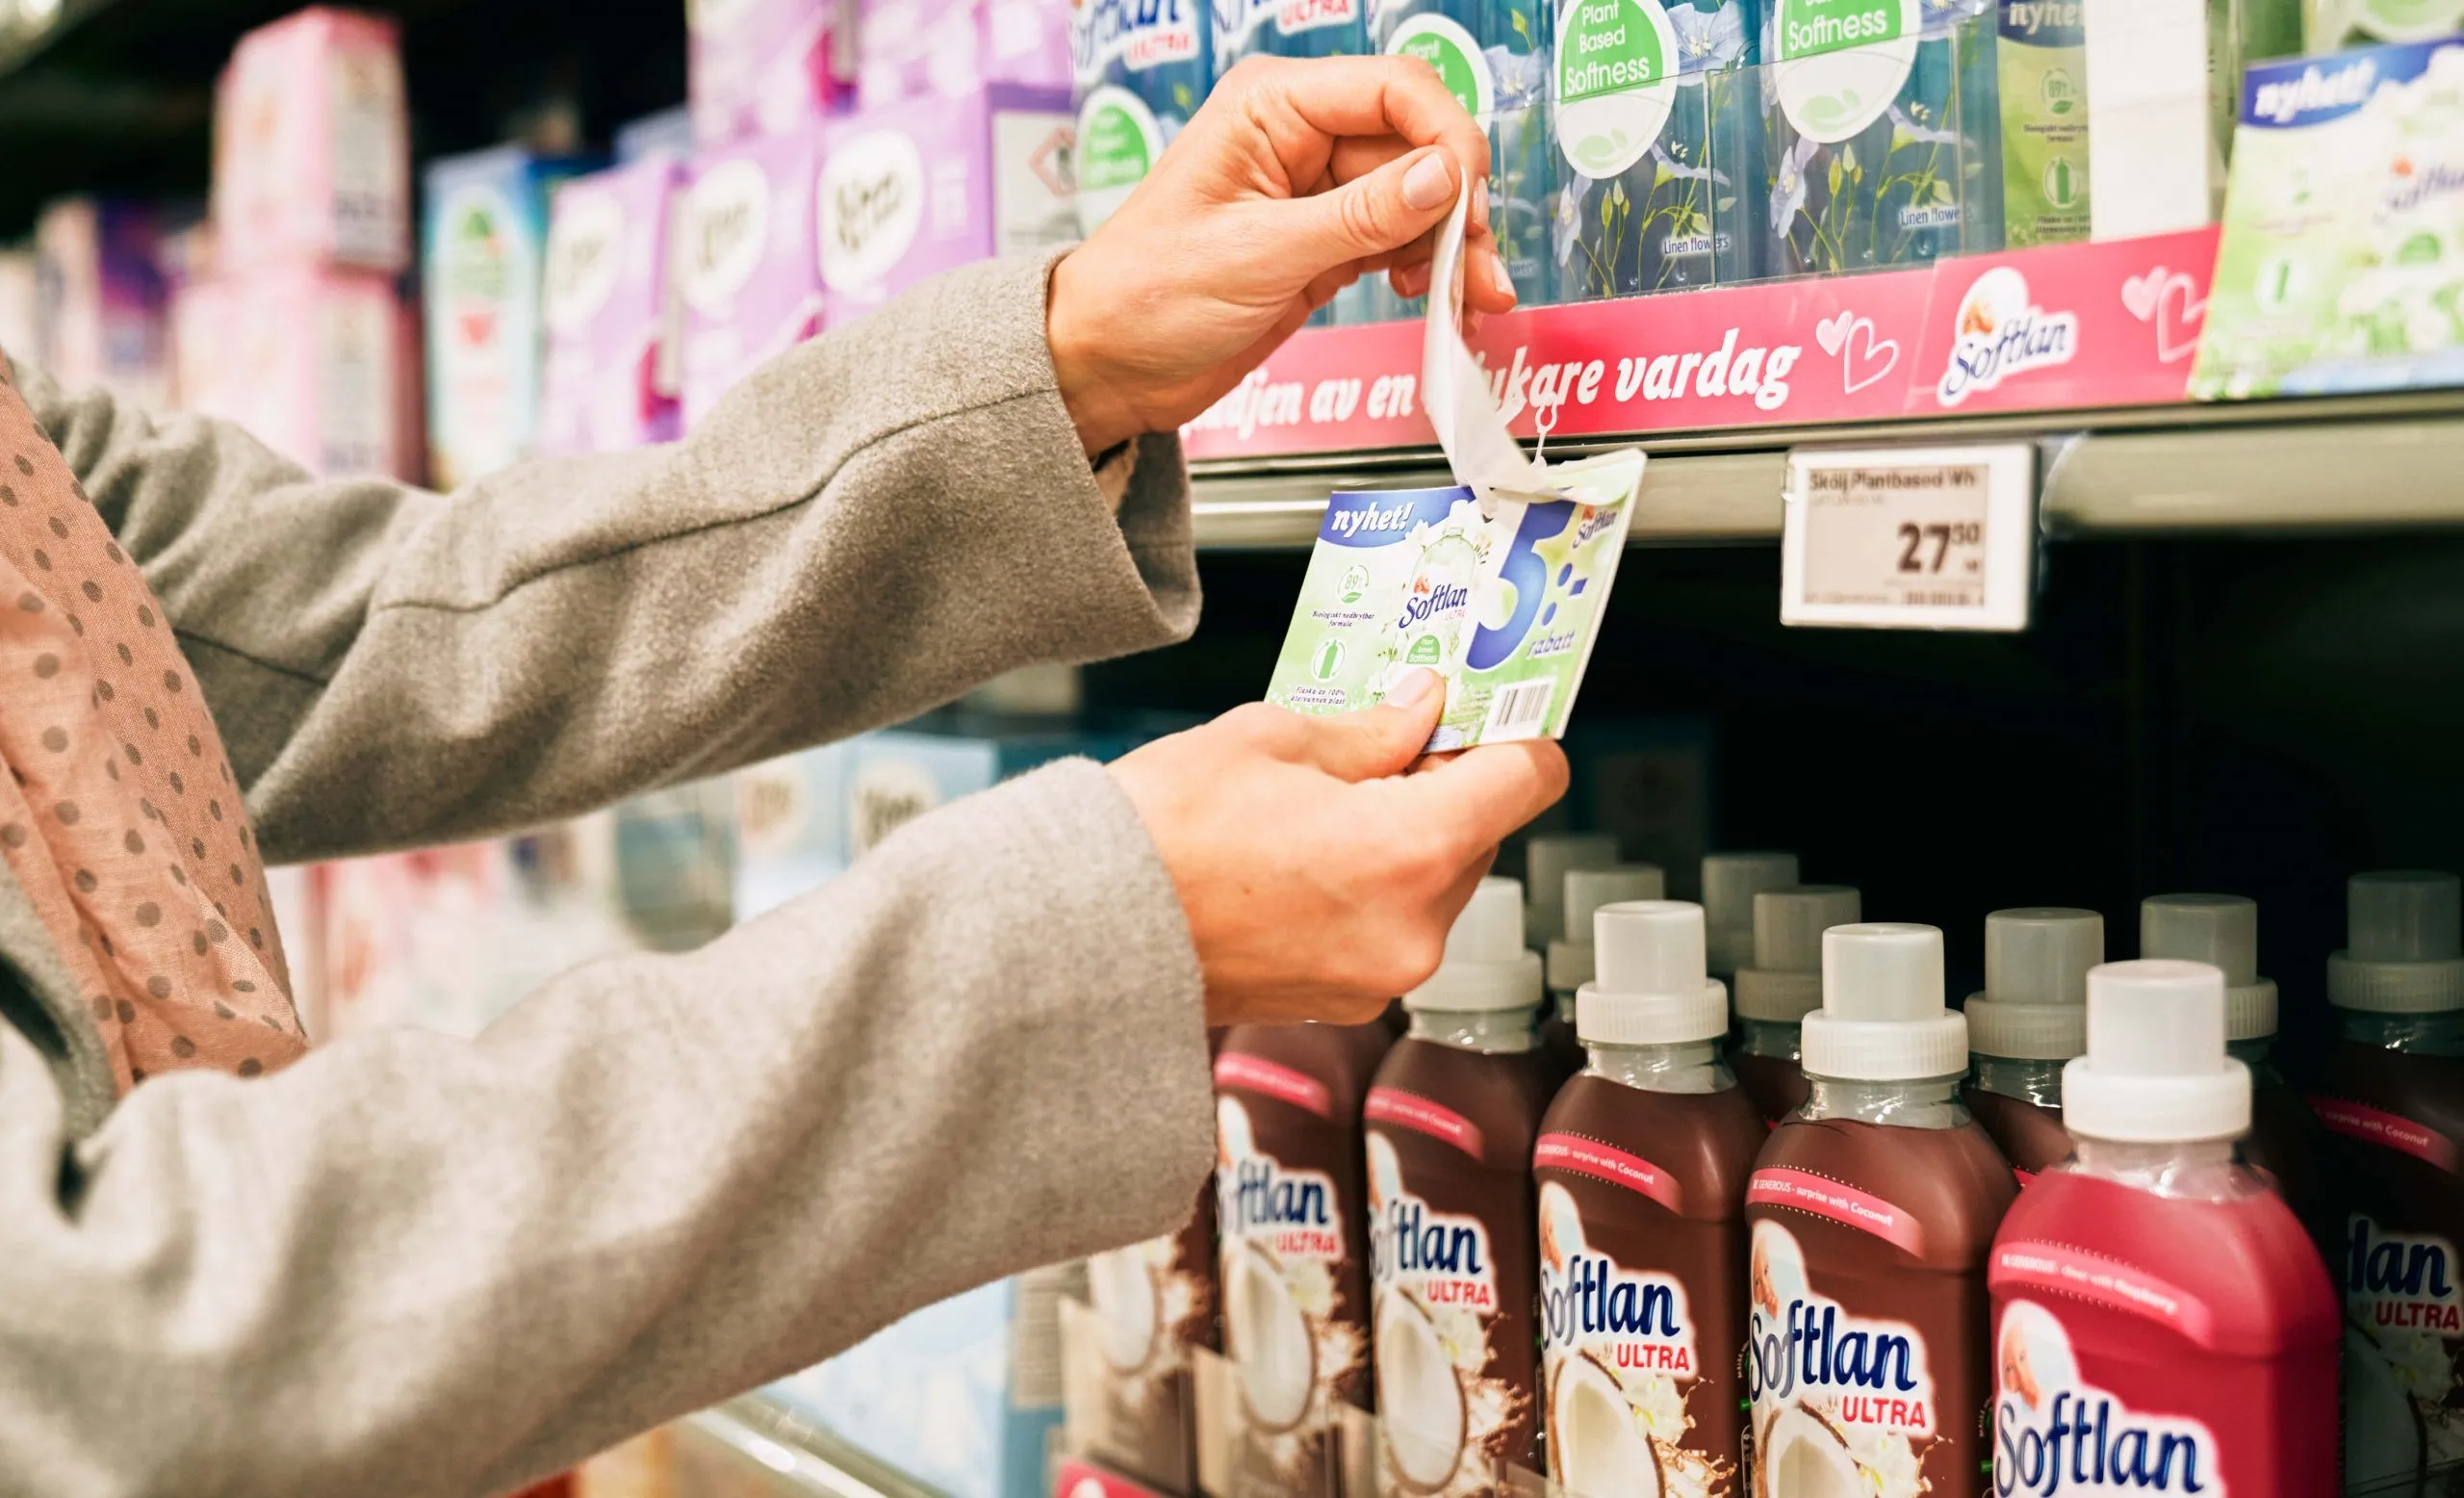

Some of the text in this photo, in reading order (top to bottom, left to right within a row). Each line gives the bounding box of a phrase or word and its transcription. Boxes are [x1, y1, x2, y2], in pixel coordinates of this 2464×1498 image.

[1279, 0, 1349, 28] ULTRA
[1581, 2, 1620, 27] Plant
[1579, 26, 1627, 54] Based
[1788, 9, 1888, 52] Softness
[1565, 56, 1651, 96] Softness
[1898, 210, 1929, 226] Linen
[1662, 241, 1689, 255] Linen
[1944, 316, 2067, 397] Softlan
[1309, 377, 1363, 423] av
[1366, 374, 1418, 419] en
[1614, 327, 1803, 411] vardag
[1851, 470, 1943, 490] Plantbased
[1331, 502, 1415, 538] nyhet!
[1399, 583, 1468, 629] Softlan
[1527, 630, 1576, 659] rabatt
[2384, 1124, 2428, 1148] Coconut
[1599, 1156, 1618, 1171] with
[1618, 1161, 1656, 1185] Coconut
[1758, 1178, 1792, 1194] GENEROUS
[1796, 1185, 1828, 1204] surprise
[1828, 1191, 1850, 1210] with
[1850, 1201, 1895, 1227] Coconut
[1276, 1231, 1337, 1253] ULTRA
[1426, 1278, 1491, 1306] ULTRA
[1542, 1253, 1681, 1352] Softlan
[2374, 1301, 2460, 1331] ULTRA
[1617, 1342, 1690, 1372] ULTRA
[1750, 1298, 1918, 1403] Softlan
[1841, 1395, 1927, 1429] ULTRA
[1995, 1390, 2204, 1498] Softlan
